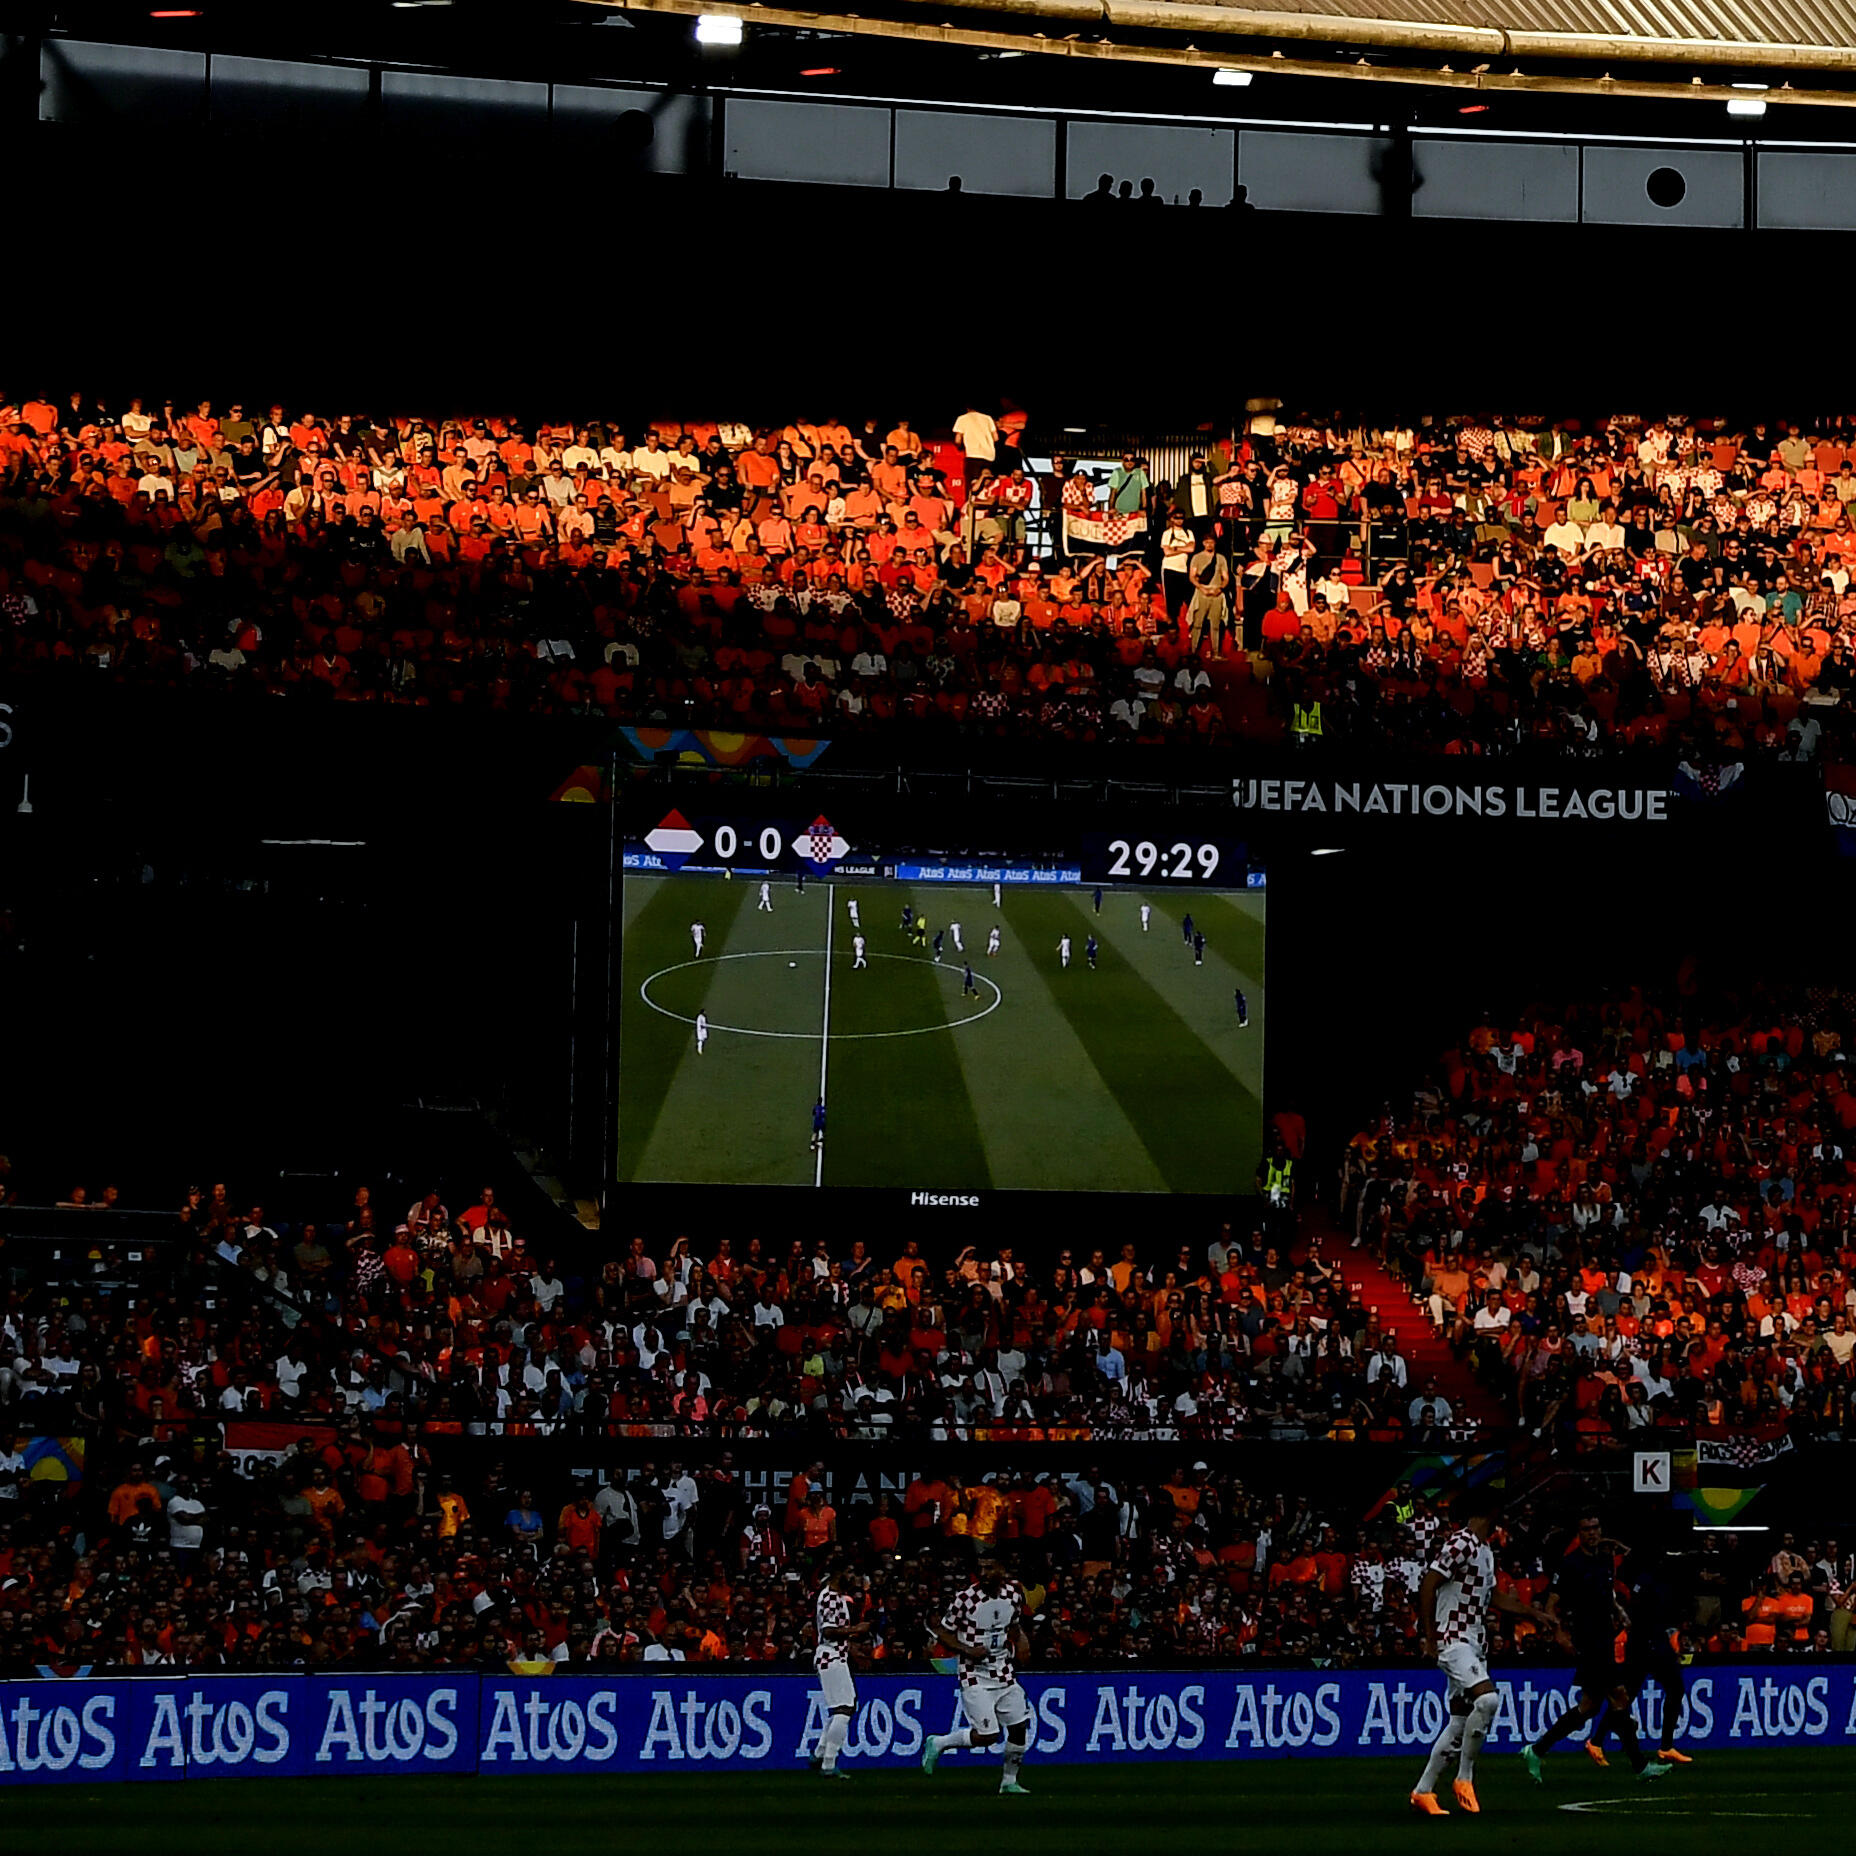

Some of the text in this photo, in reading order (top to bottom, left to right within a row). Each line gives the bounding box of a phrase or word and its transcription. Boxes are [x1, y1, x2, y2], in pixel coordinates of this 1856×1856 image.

[1231, 778, 1669, 821] UEFA NATIONS LEAGUE
[1107, 840, 1220, 879] 29:29
[911, 1191, 980, 1207] Hisense
[1642, 1459, 1662, 1485] K
